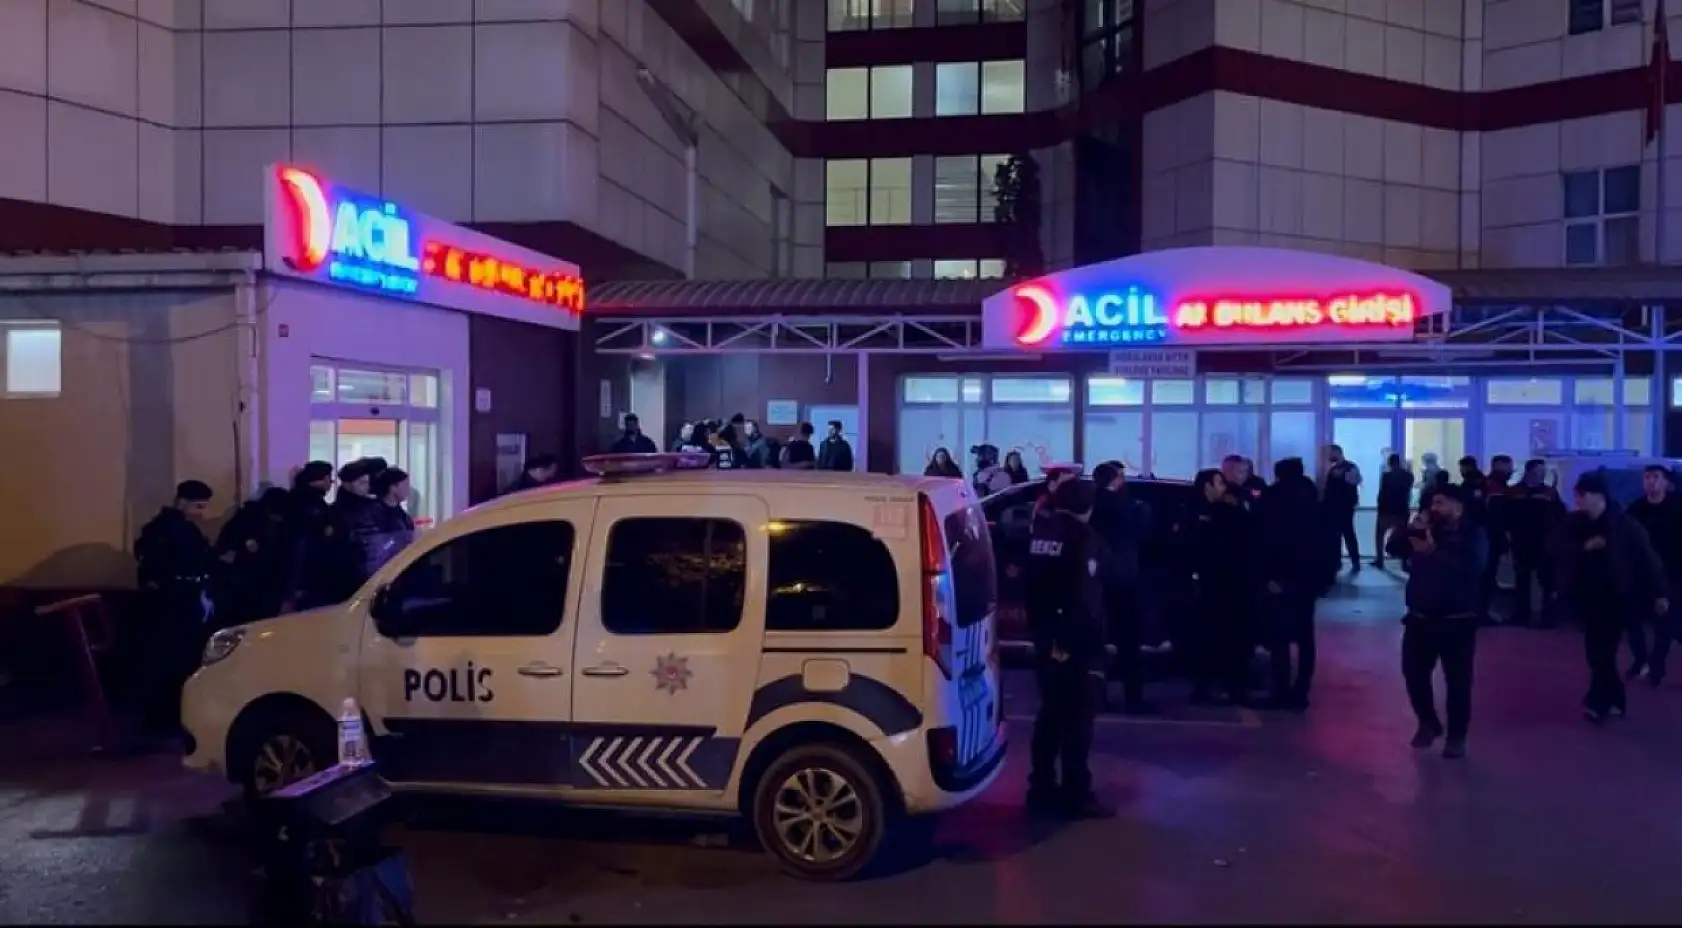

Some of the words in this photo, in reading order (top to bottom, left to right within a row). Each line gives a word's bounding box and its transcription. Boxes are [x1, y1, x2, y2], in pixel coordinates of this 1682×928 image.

[1066, 288, 1167, 325] ACİL
[1063, 329, 1166, 342] EMERGENCY
[404, 660, 494, 702] POLİS
